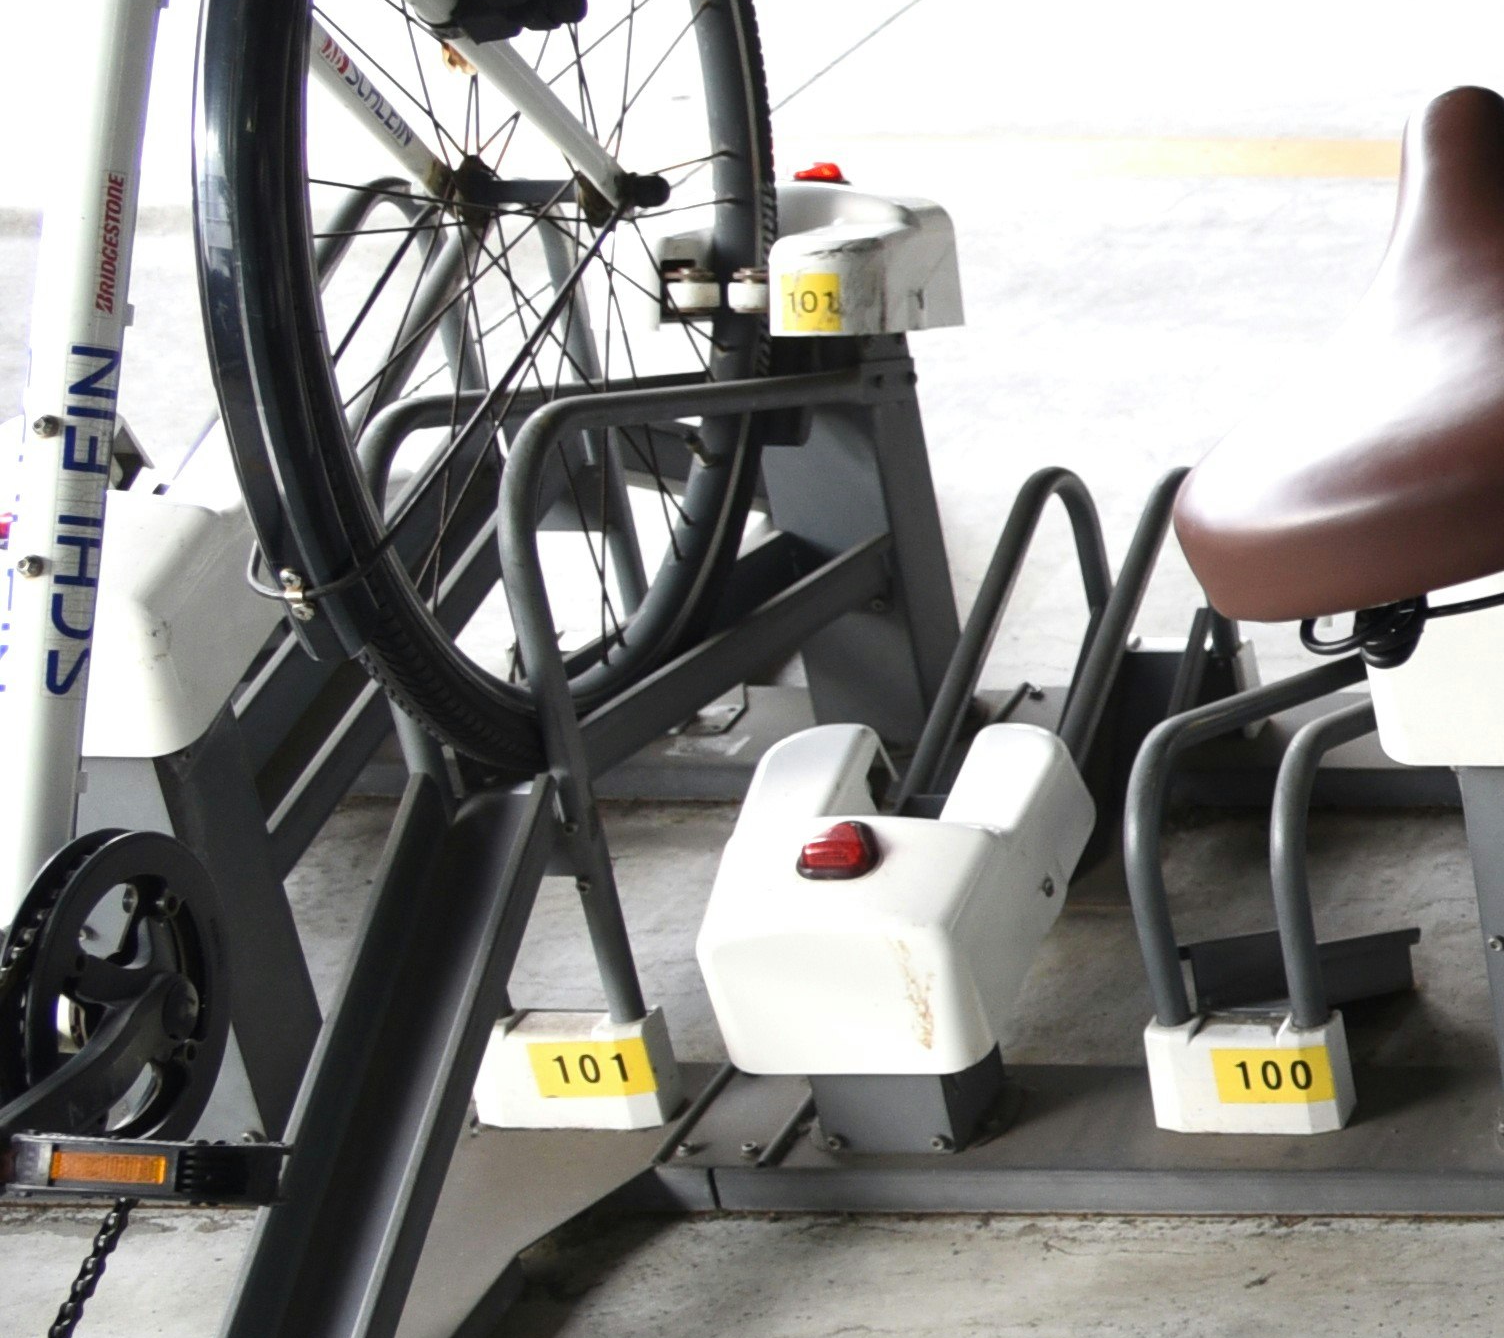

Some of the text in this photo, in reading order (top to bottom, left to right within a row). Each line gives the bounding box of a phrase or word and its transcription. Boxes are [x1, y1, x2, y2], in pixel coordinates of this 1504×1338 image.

[95, 173, 125, 314] BRIDGESTONE
[787, 289, 841, 314] 101
[552, 1052, 629, 1084] 101
[1235, 1060, 1313, 1090] 100
